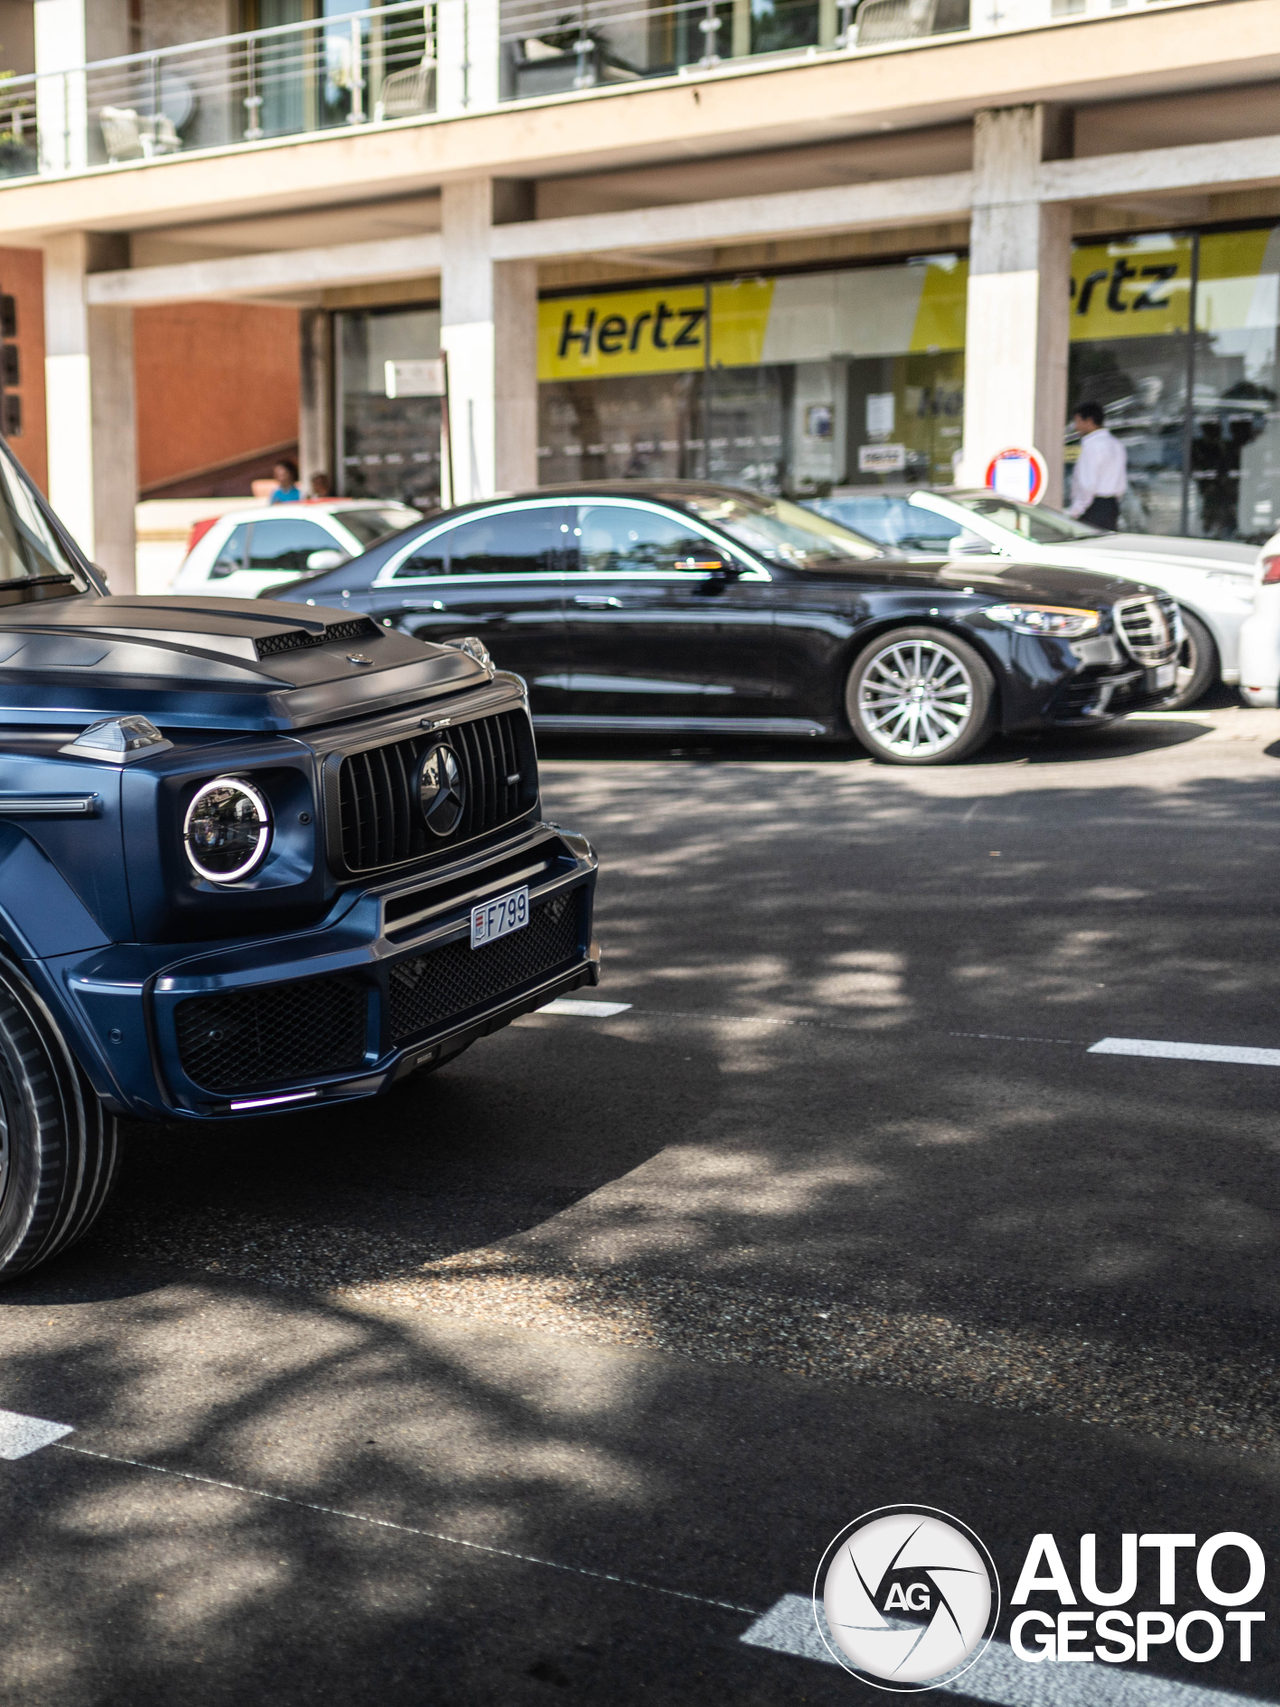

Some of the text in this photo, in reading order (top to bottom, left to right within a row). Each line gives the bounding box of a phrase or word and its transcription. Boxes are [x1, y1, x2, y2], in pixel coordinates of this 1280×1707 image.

[1070, 258, 1178, 315] rtz
[557, 302, 706, 358] Hertz
[487, 893, 526, 938] F799
